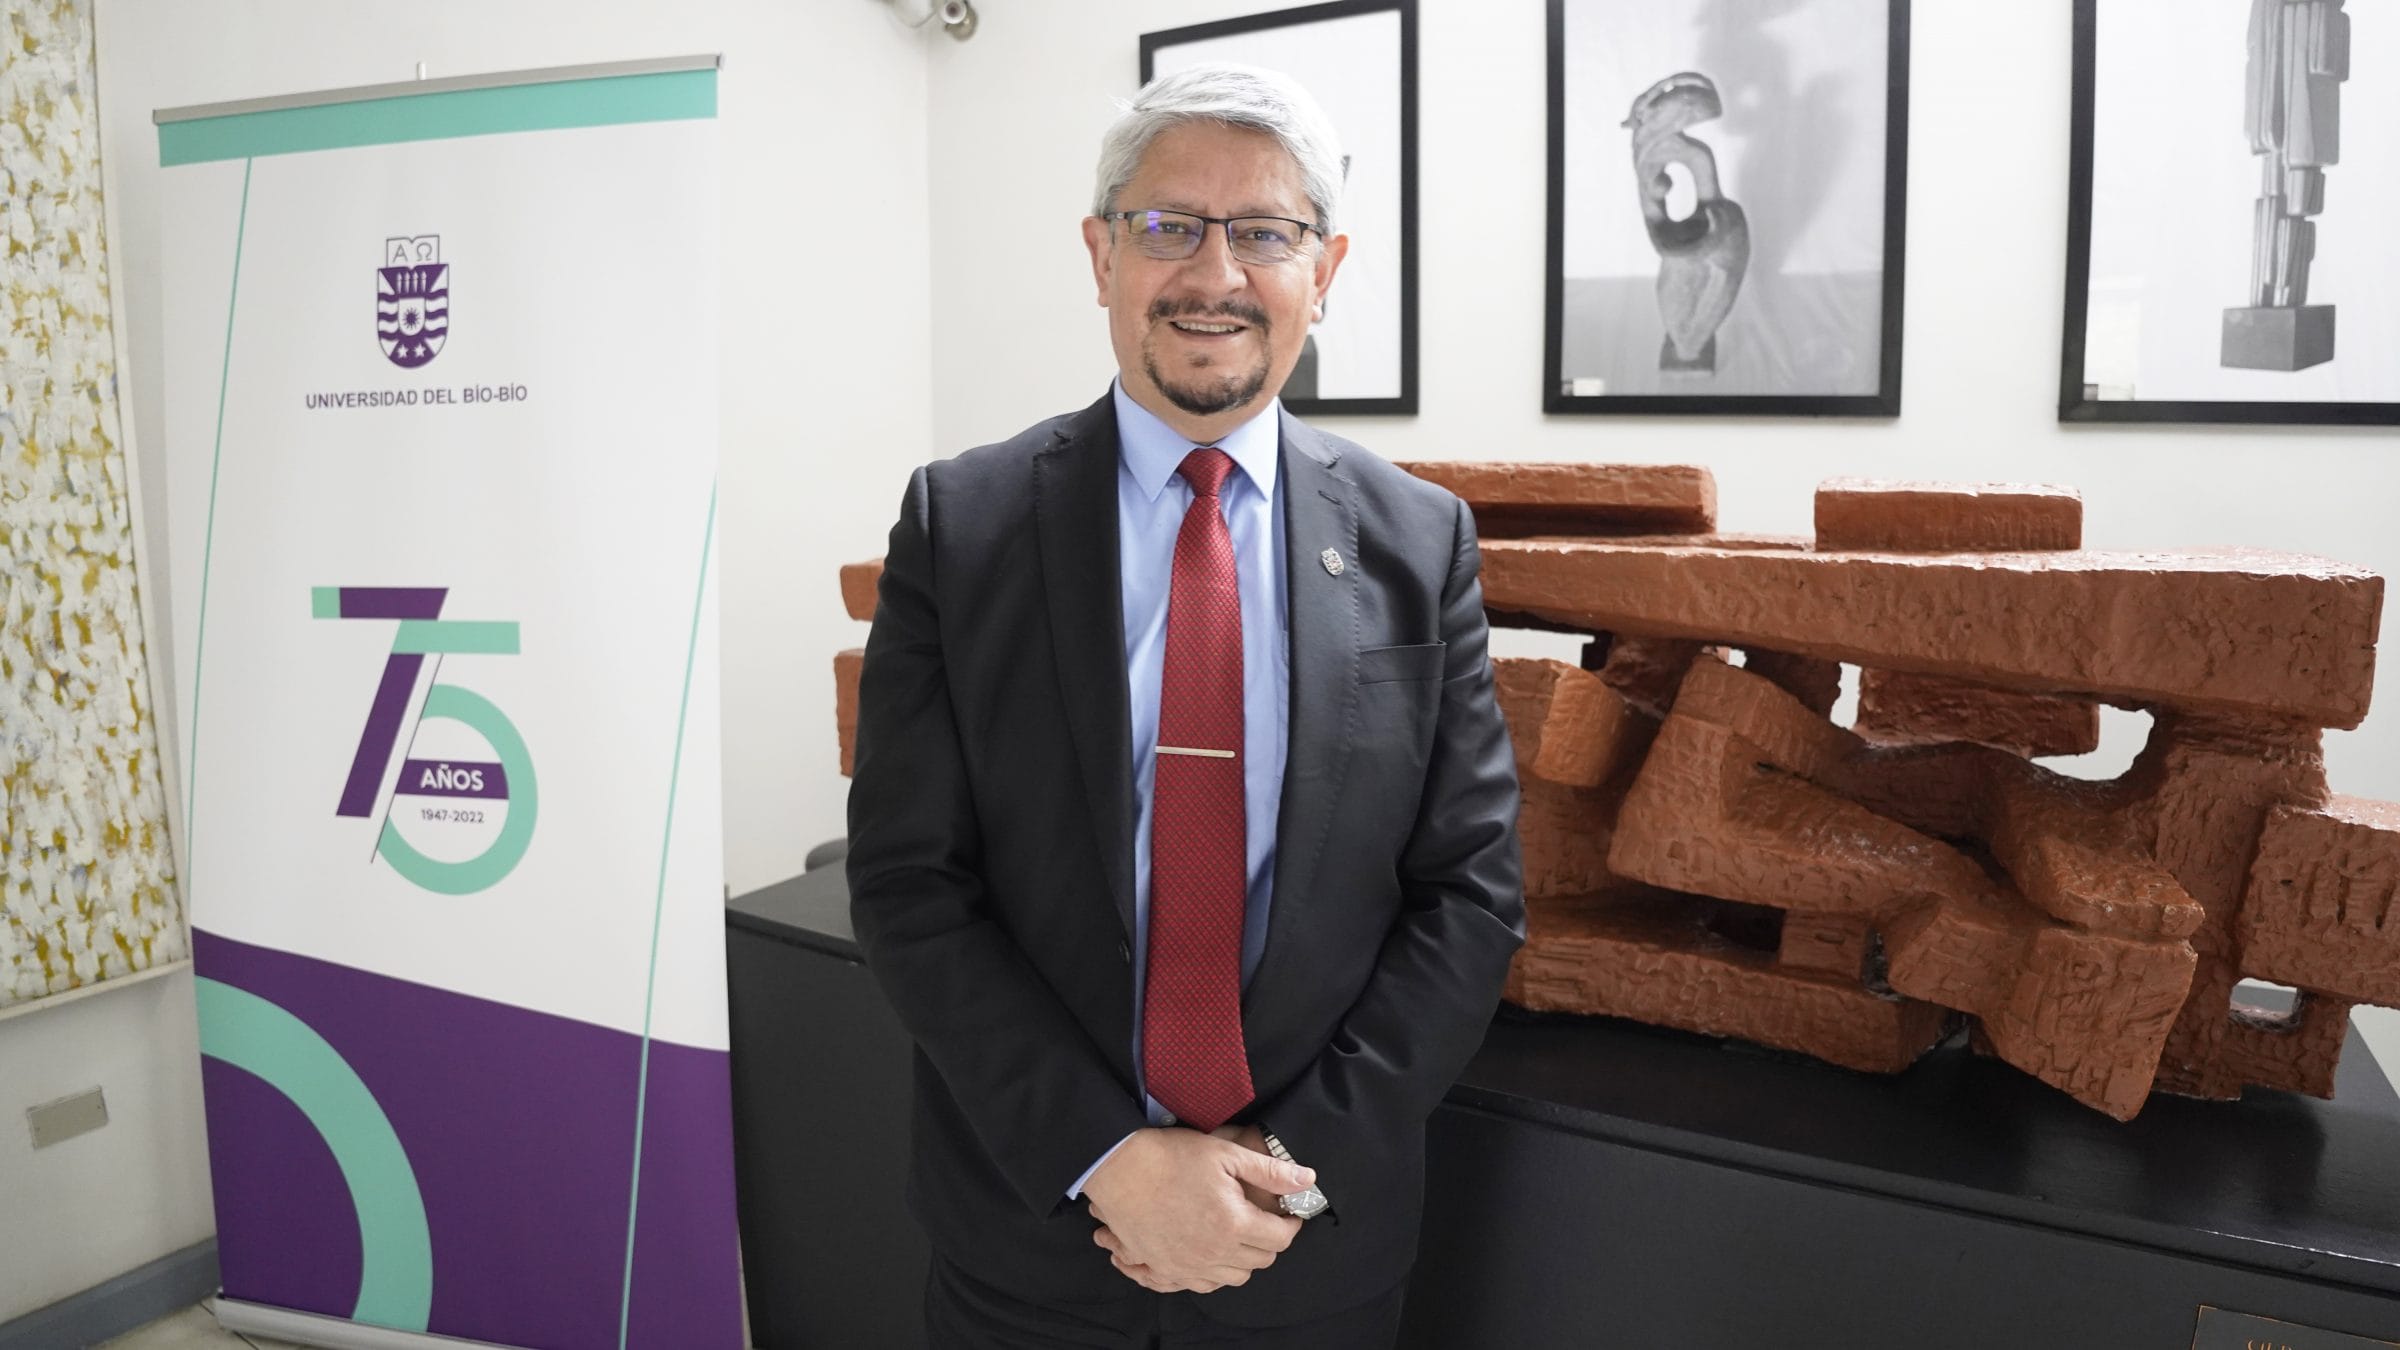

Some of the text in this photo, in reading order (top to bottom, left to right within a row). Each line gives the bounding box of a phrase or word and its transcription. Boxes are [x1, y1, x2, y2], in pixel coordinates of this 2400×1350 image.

[306, 384, 528, 409] UNIVERSIDAD DEL BÍO-BÍO
[311, 586, 538, 895] 75
[420, 763, 484, 791] AÑOS
[421, 808, 484, 824] 1947-2022
